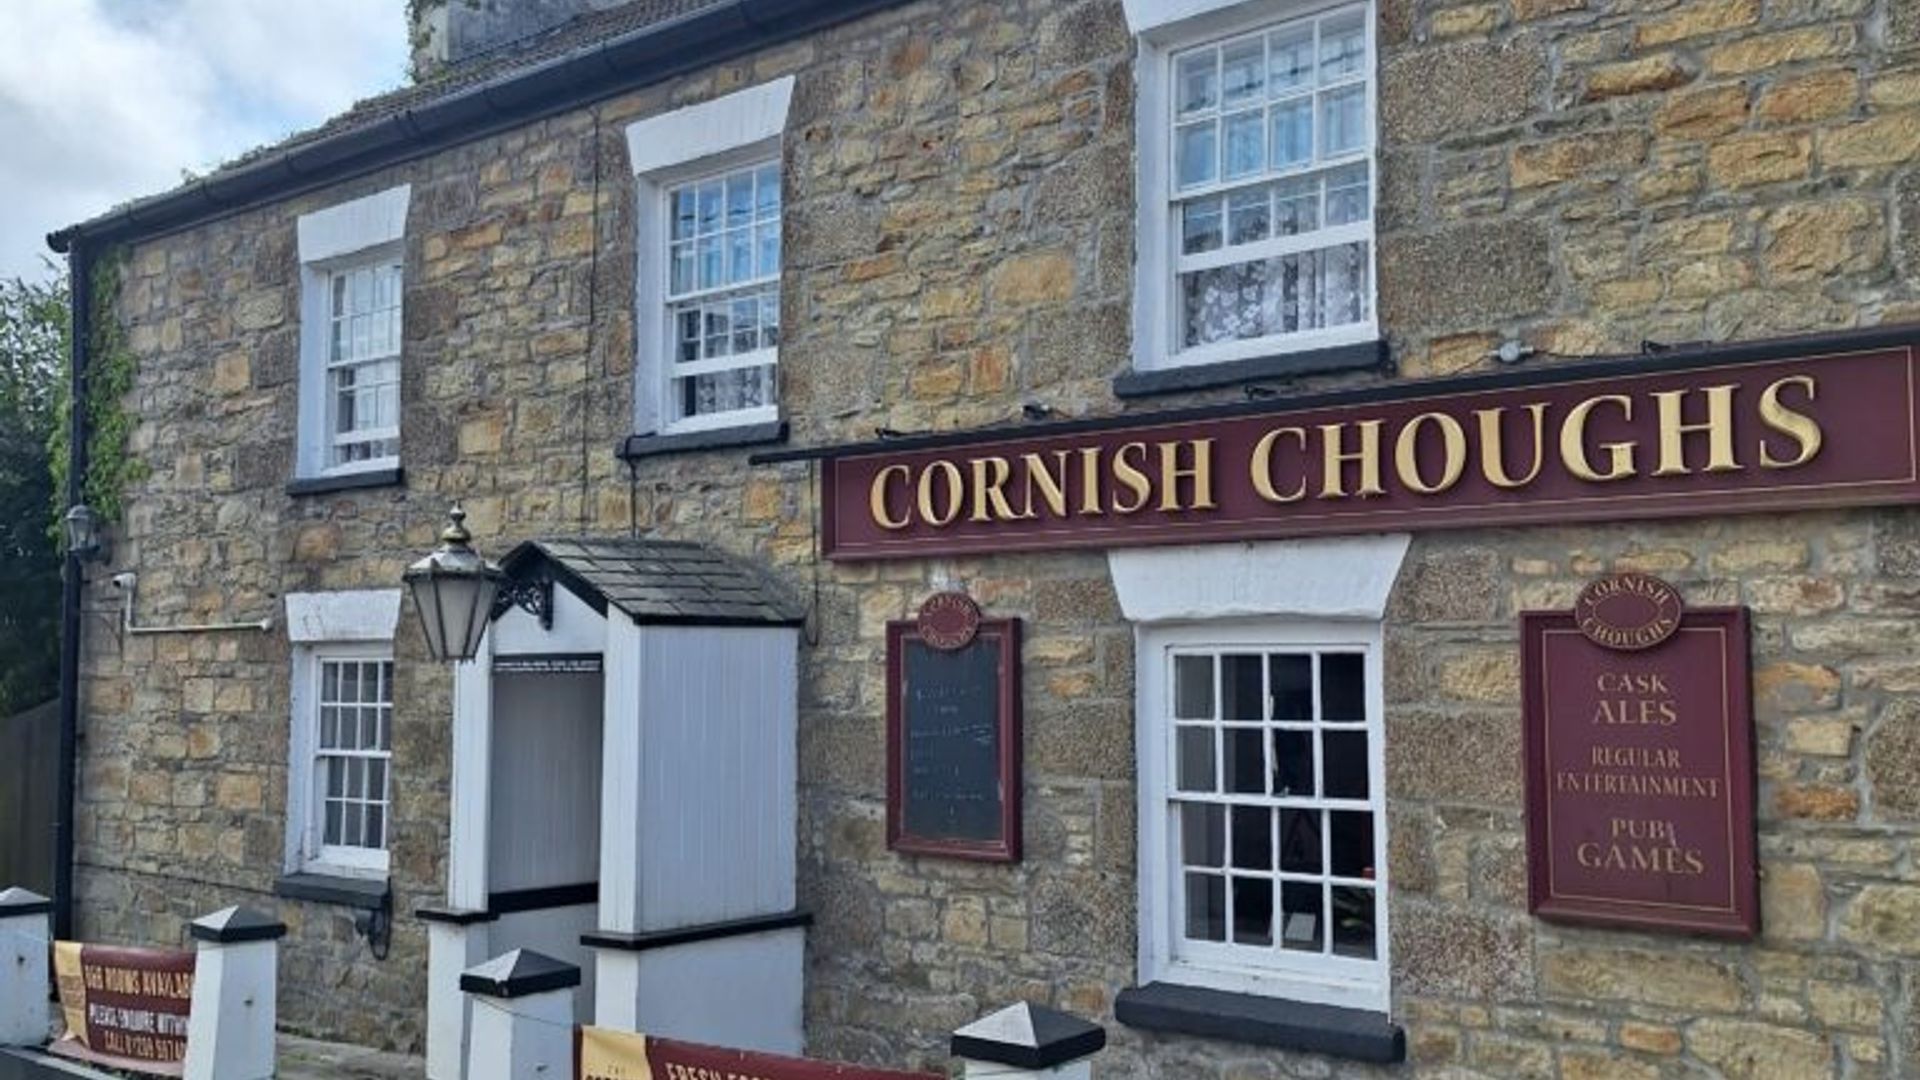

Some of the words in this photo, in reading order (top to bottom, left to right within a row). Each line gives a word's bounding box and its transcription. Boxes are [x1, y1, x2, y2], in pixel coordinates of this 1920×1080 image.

[869, 438, 1219, 529] CORNISH
[1250, 375, 1823, 502] CHOUGHS
[1585, 577, 1670, 606] CORNISH
[1583, 618, 1672, 645] CHOUGHS
[1597, 673, 1668, 693] CASK
[1592, 700, 1677, 726] ALES
[1592, 746, 1681, 769] REGULAR
[1557, 772, 1720, 798] ENTERTAINMENT
[1611, 818, 1665, 840] PUB
[1577, 842, 1704, 874] GAMES
